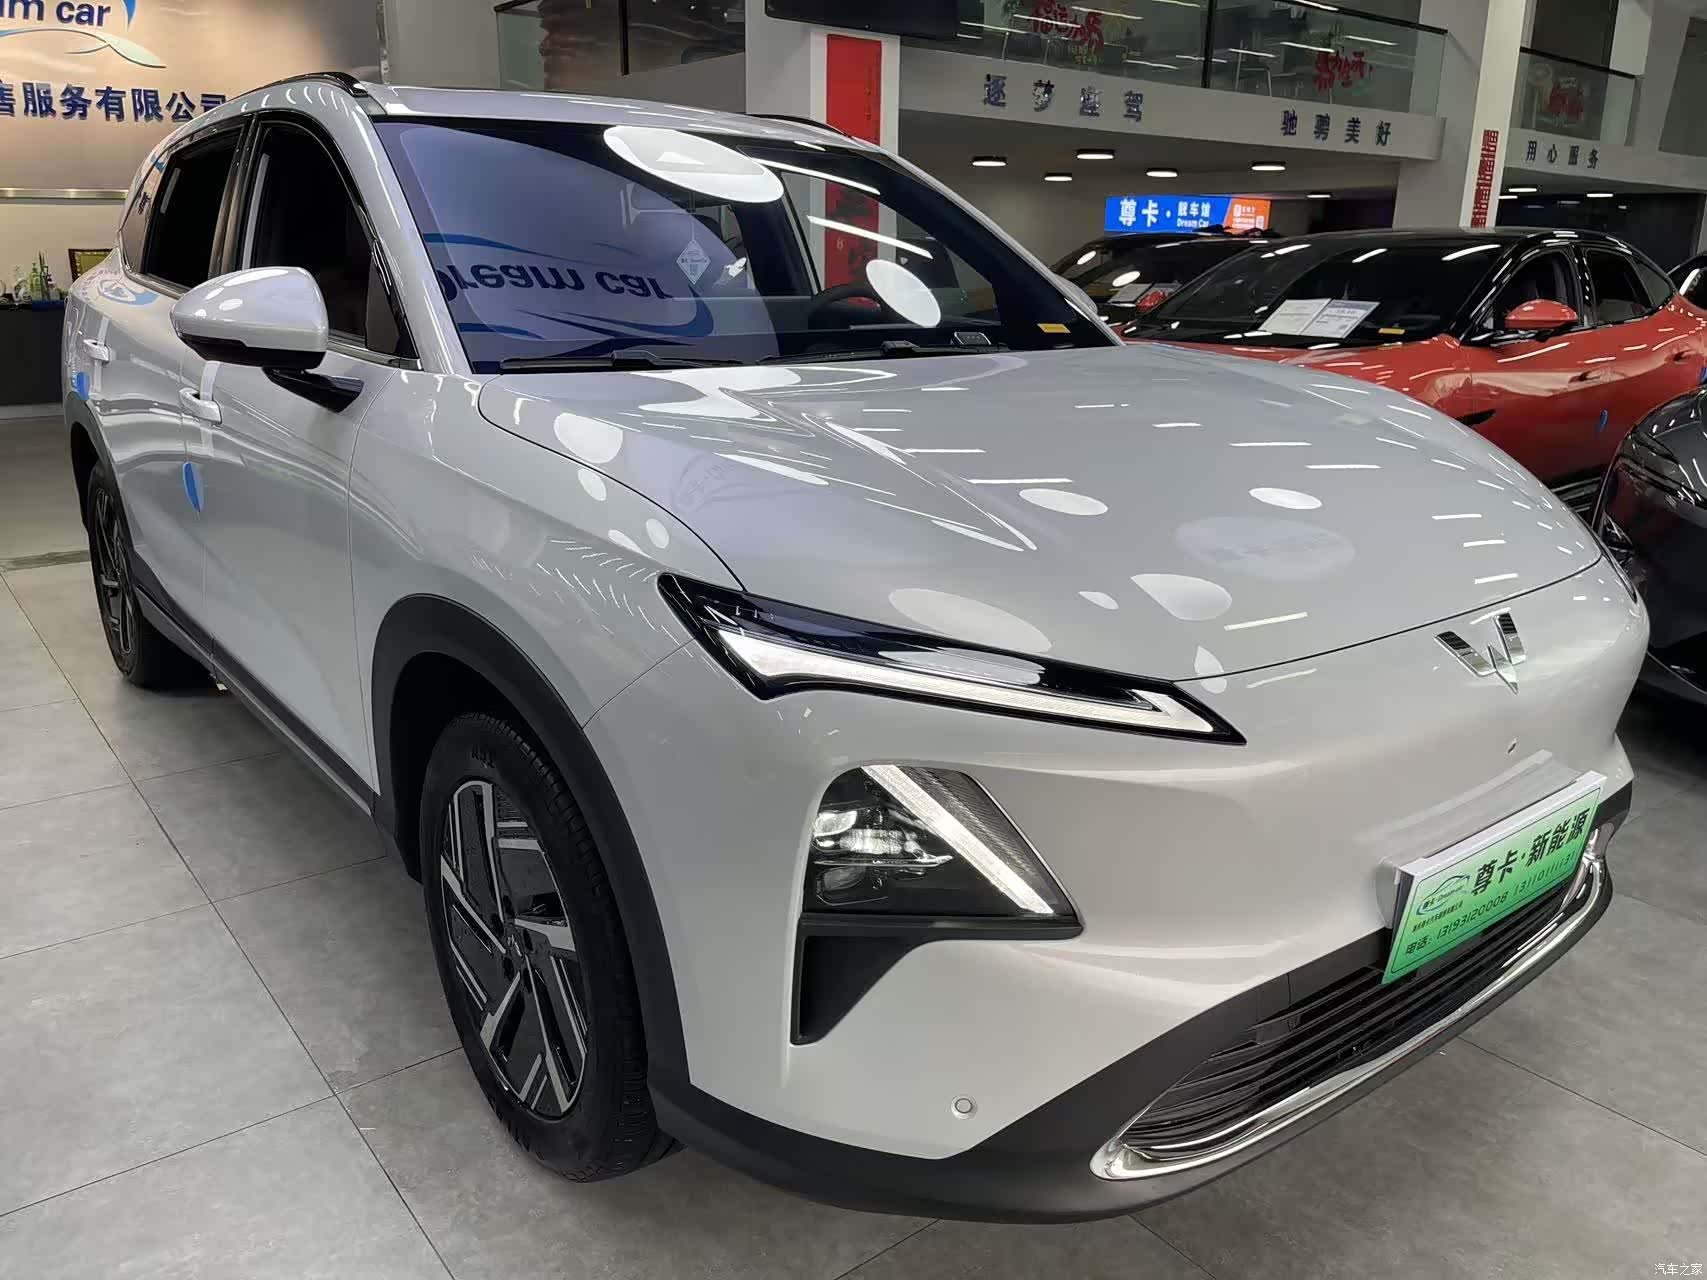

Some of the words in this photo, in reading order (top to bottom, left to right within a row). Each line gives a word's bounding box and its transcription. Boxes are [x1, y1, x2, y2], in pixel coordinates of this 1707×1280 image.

[56, 1, 111, 27] car
[1281, 109, 1391, 146] 驰骋美好
[1526, 140, 1599, 169] 用心服务
